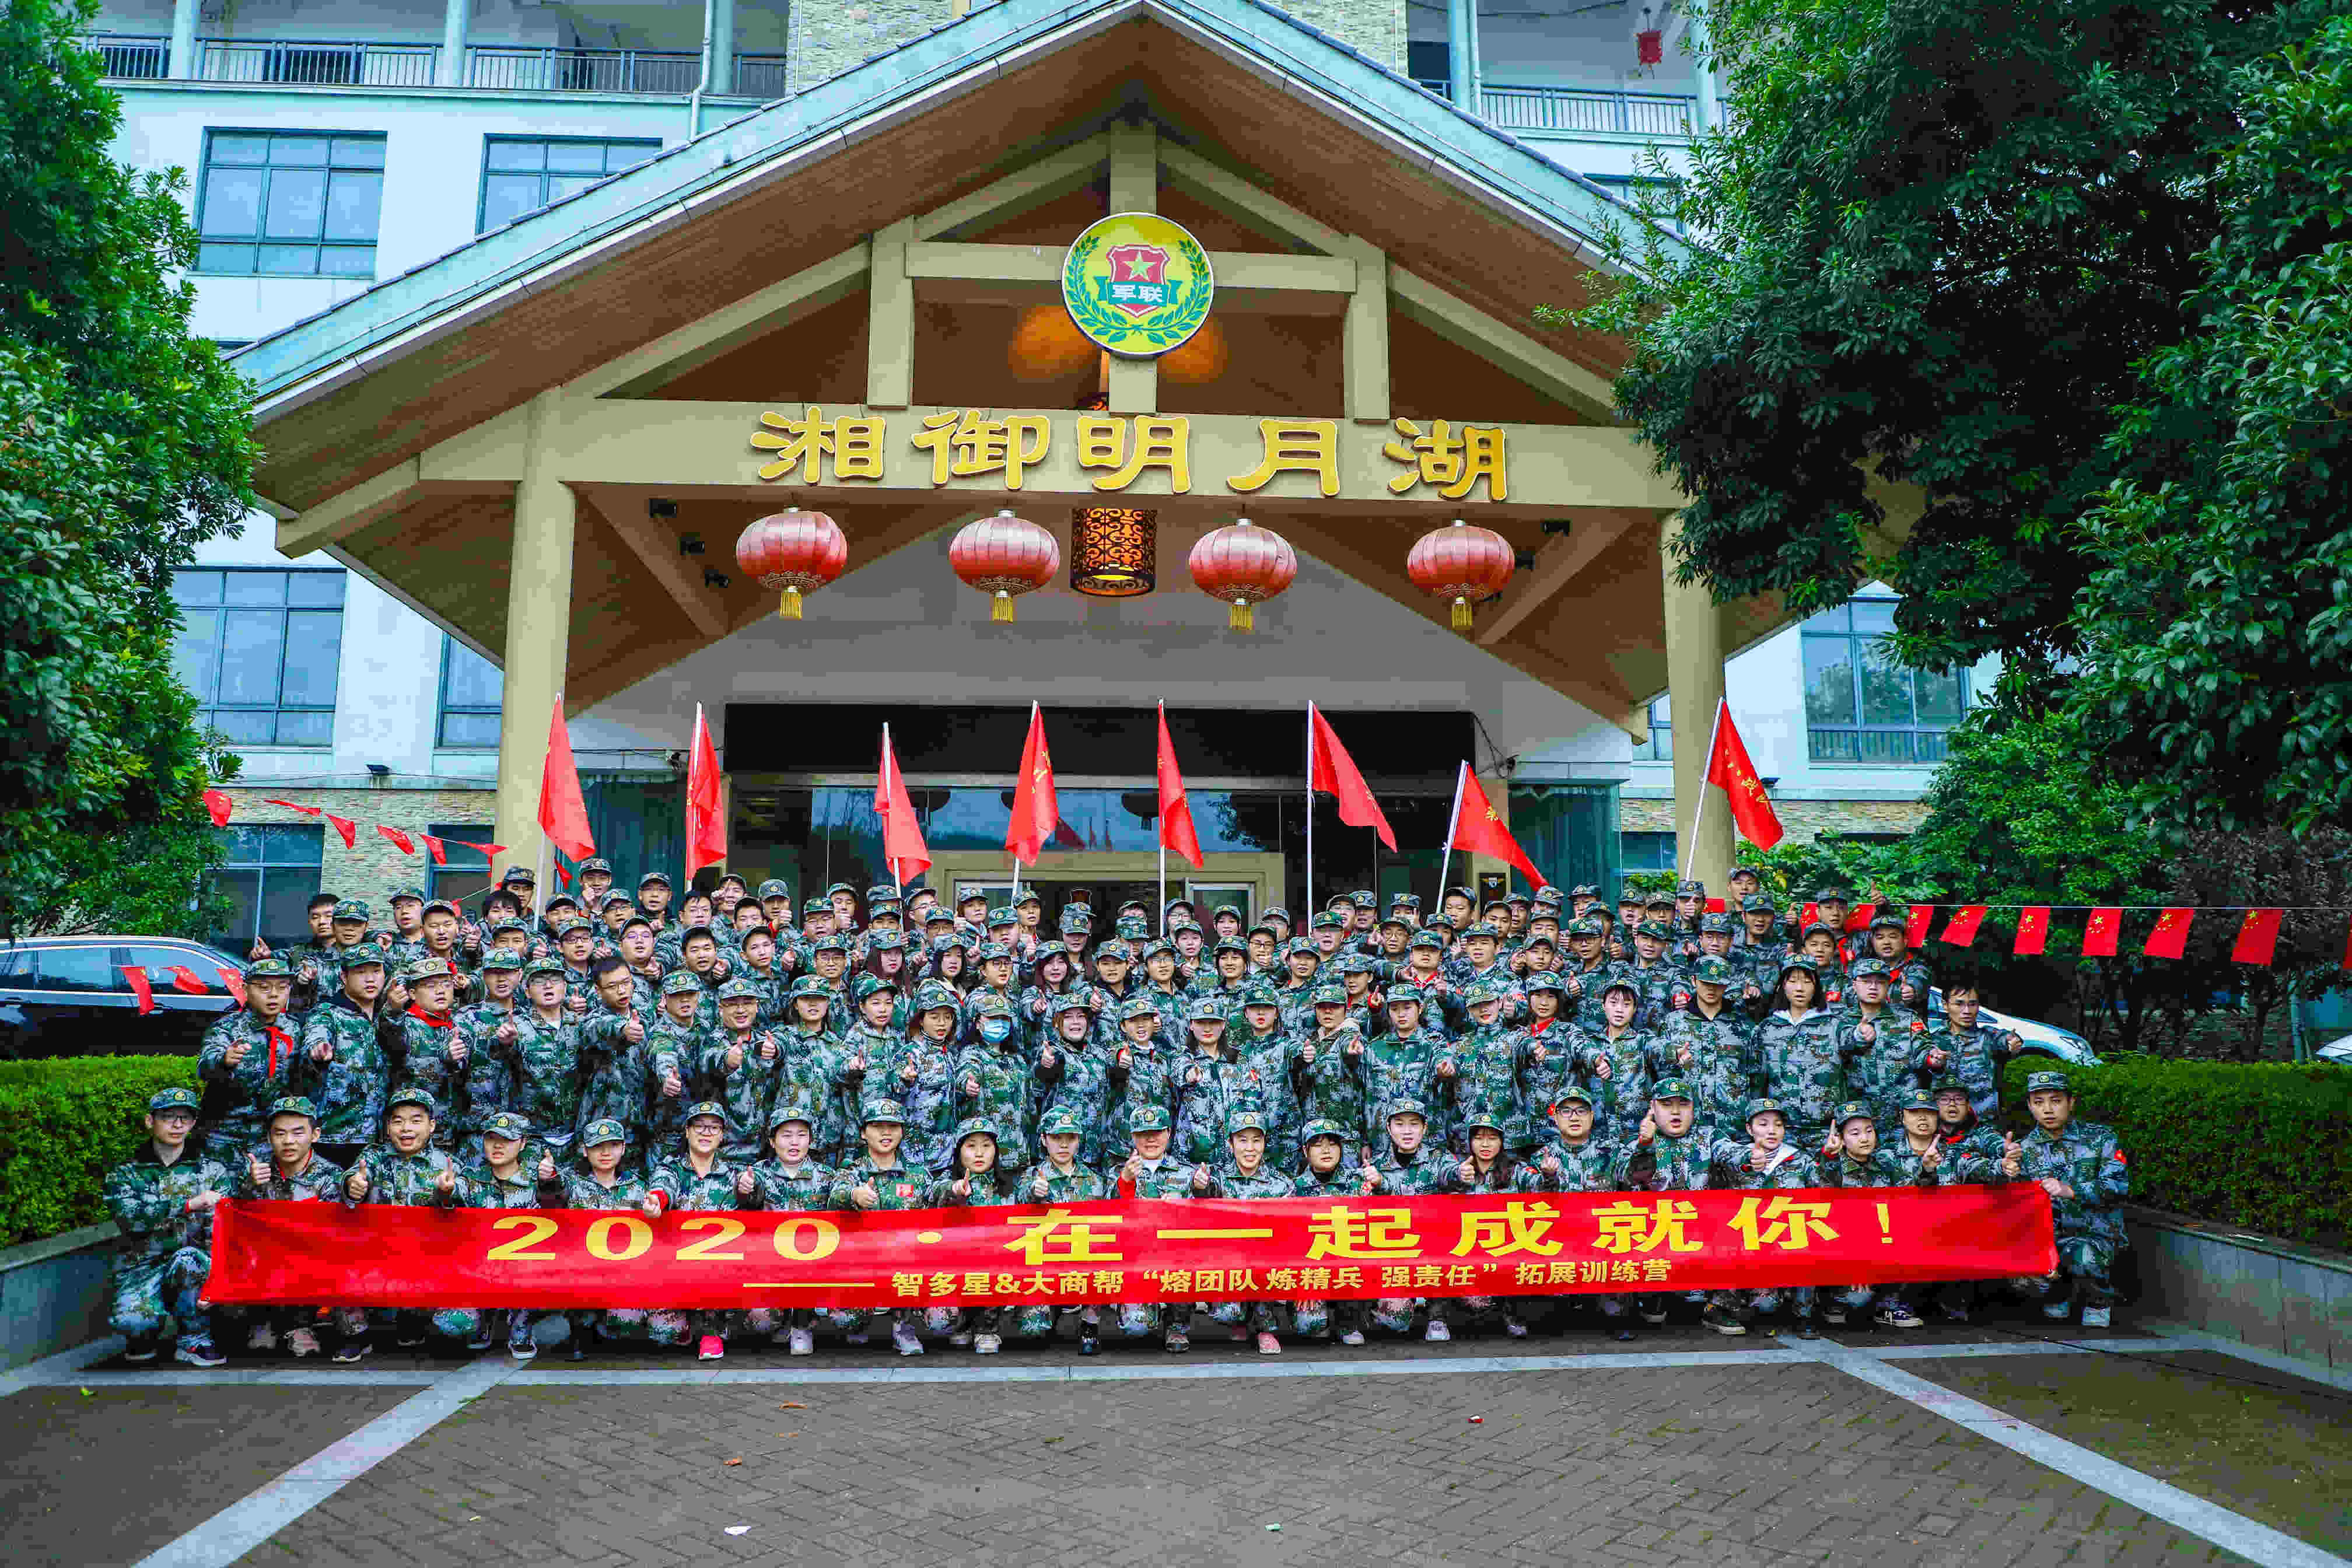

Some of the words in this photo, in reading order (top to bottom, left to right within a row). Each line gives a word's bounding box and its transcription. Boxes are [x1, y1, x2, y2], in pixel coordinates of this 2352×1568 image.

[750, 405, 1509, 501] 湘御明月湖
